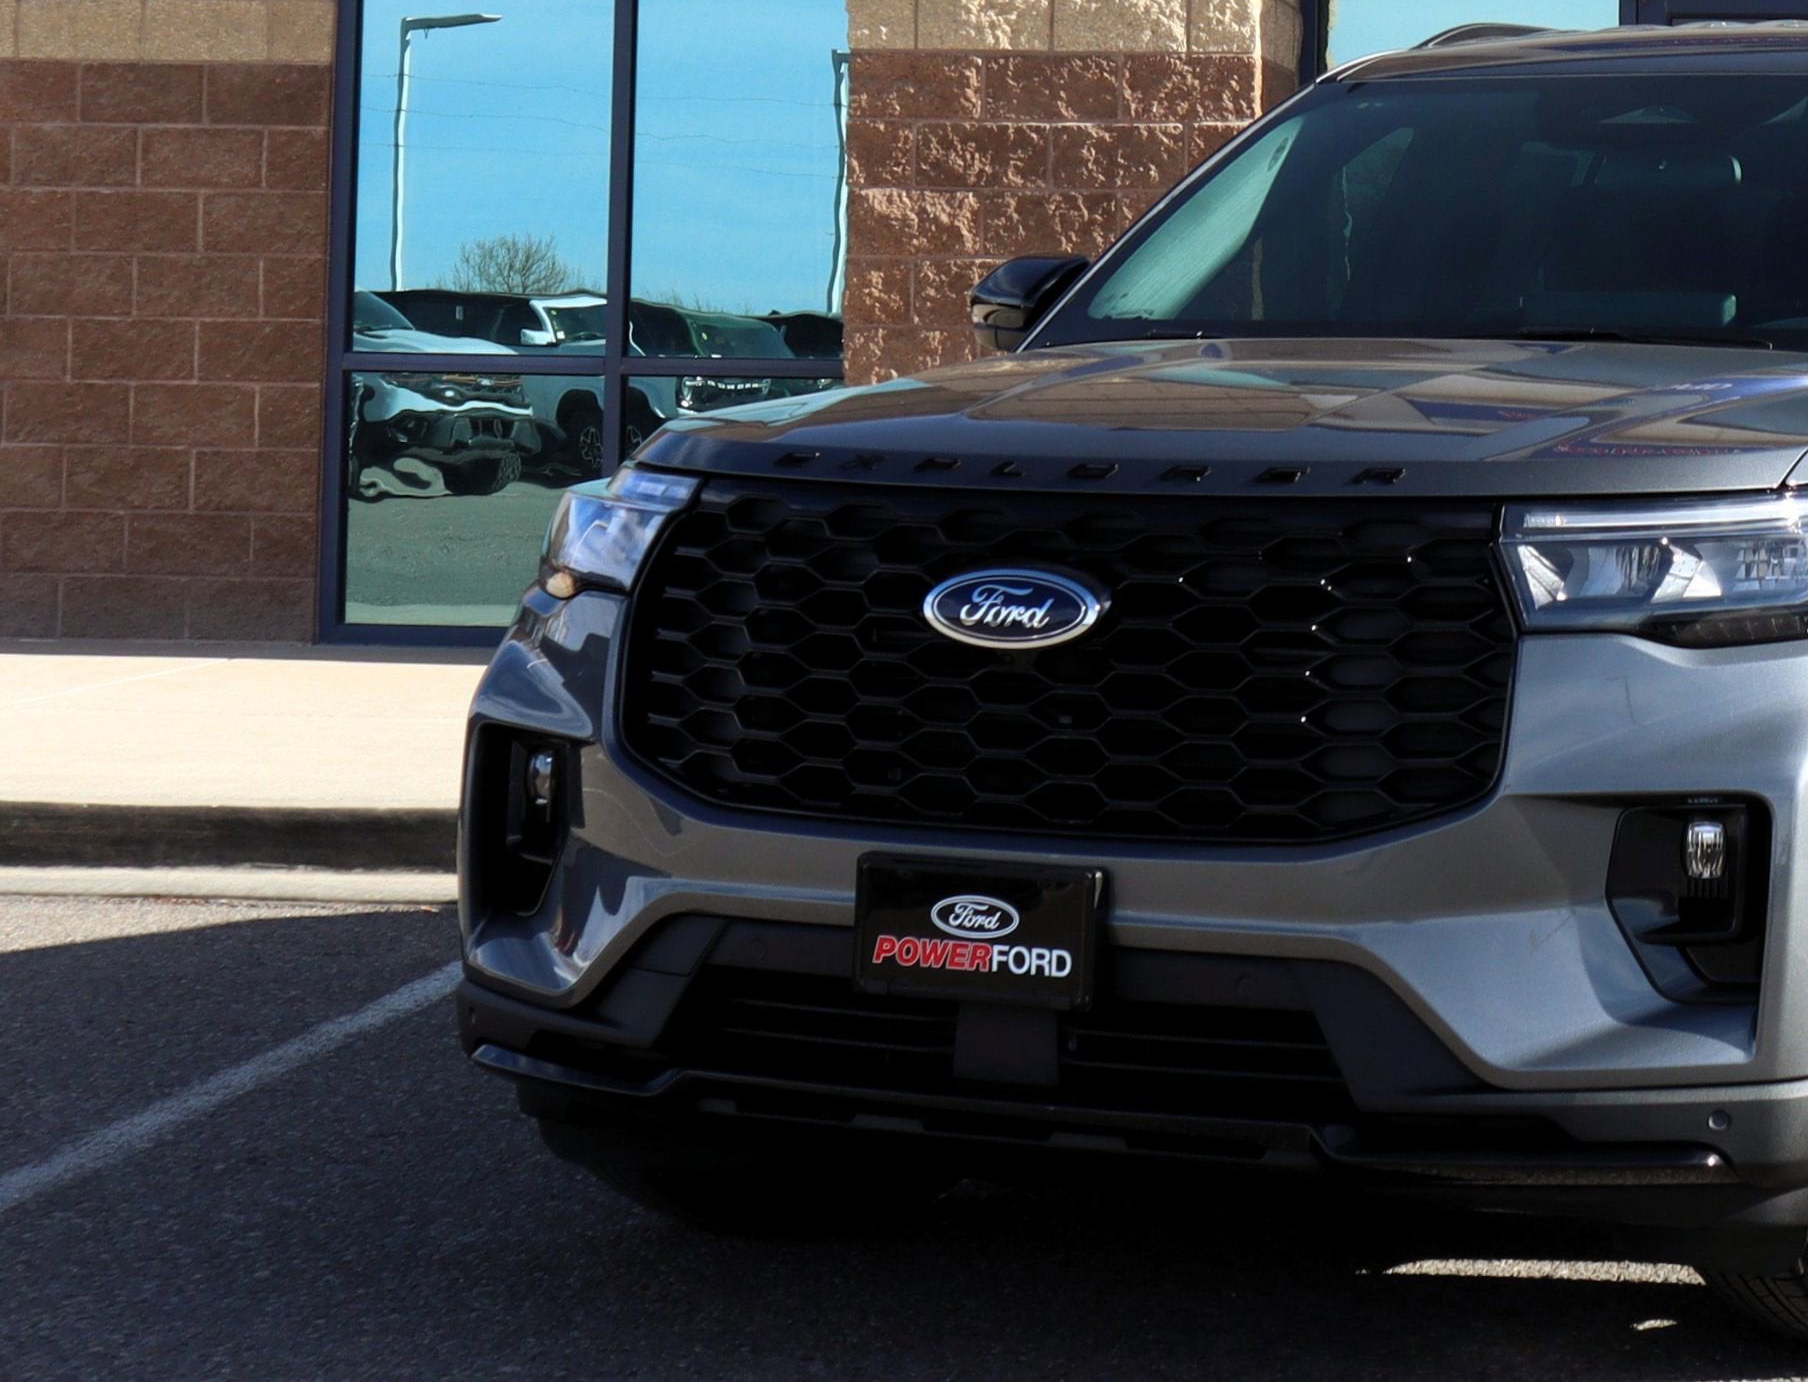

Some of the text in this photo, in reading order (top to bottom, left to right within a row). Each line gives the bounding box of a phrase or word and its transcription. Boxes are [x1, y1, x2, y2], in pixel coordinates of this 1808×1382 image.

[960, 584, 1054, 628] Ford
[949, 902, 1001, 929] Ford
[872, 935, 1072, 977] POWERFORD
